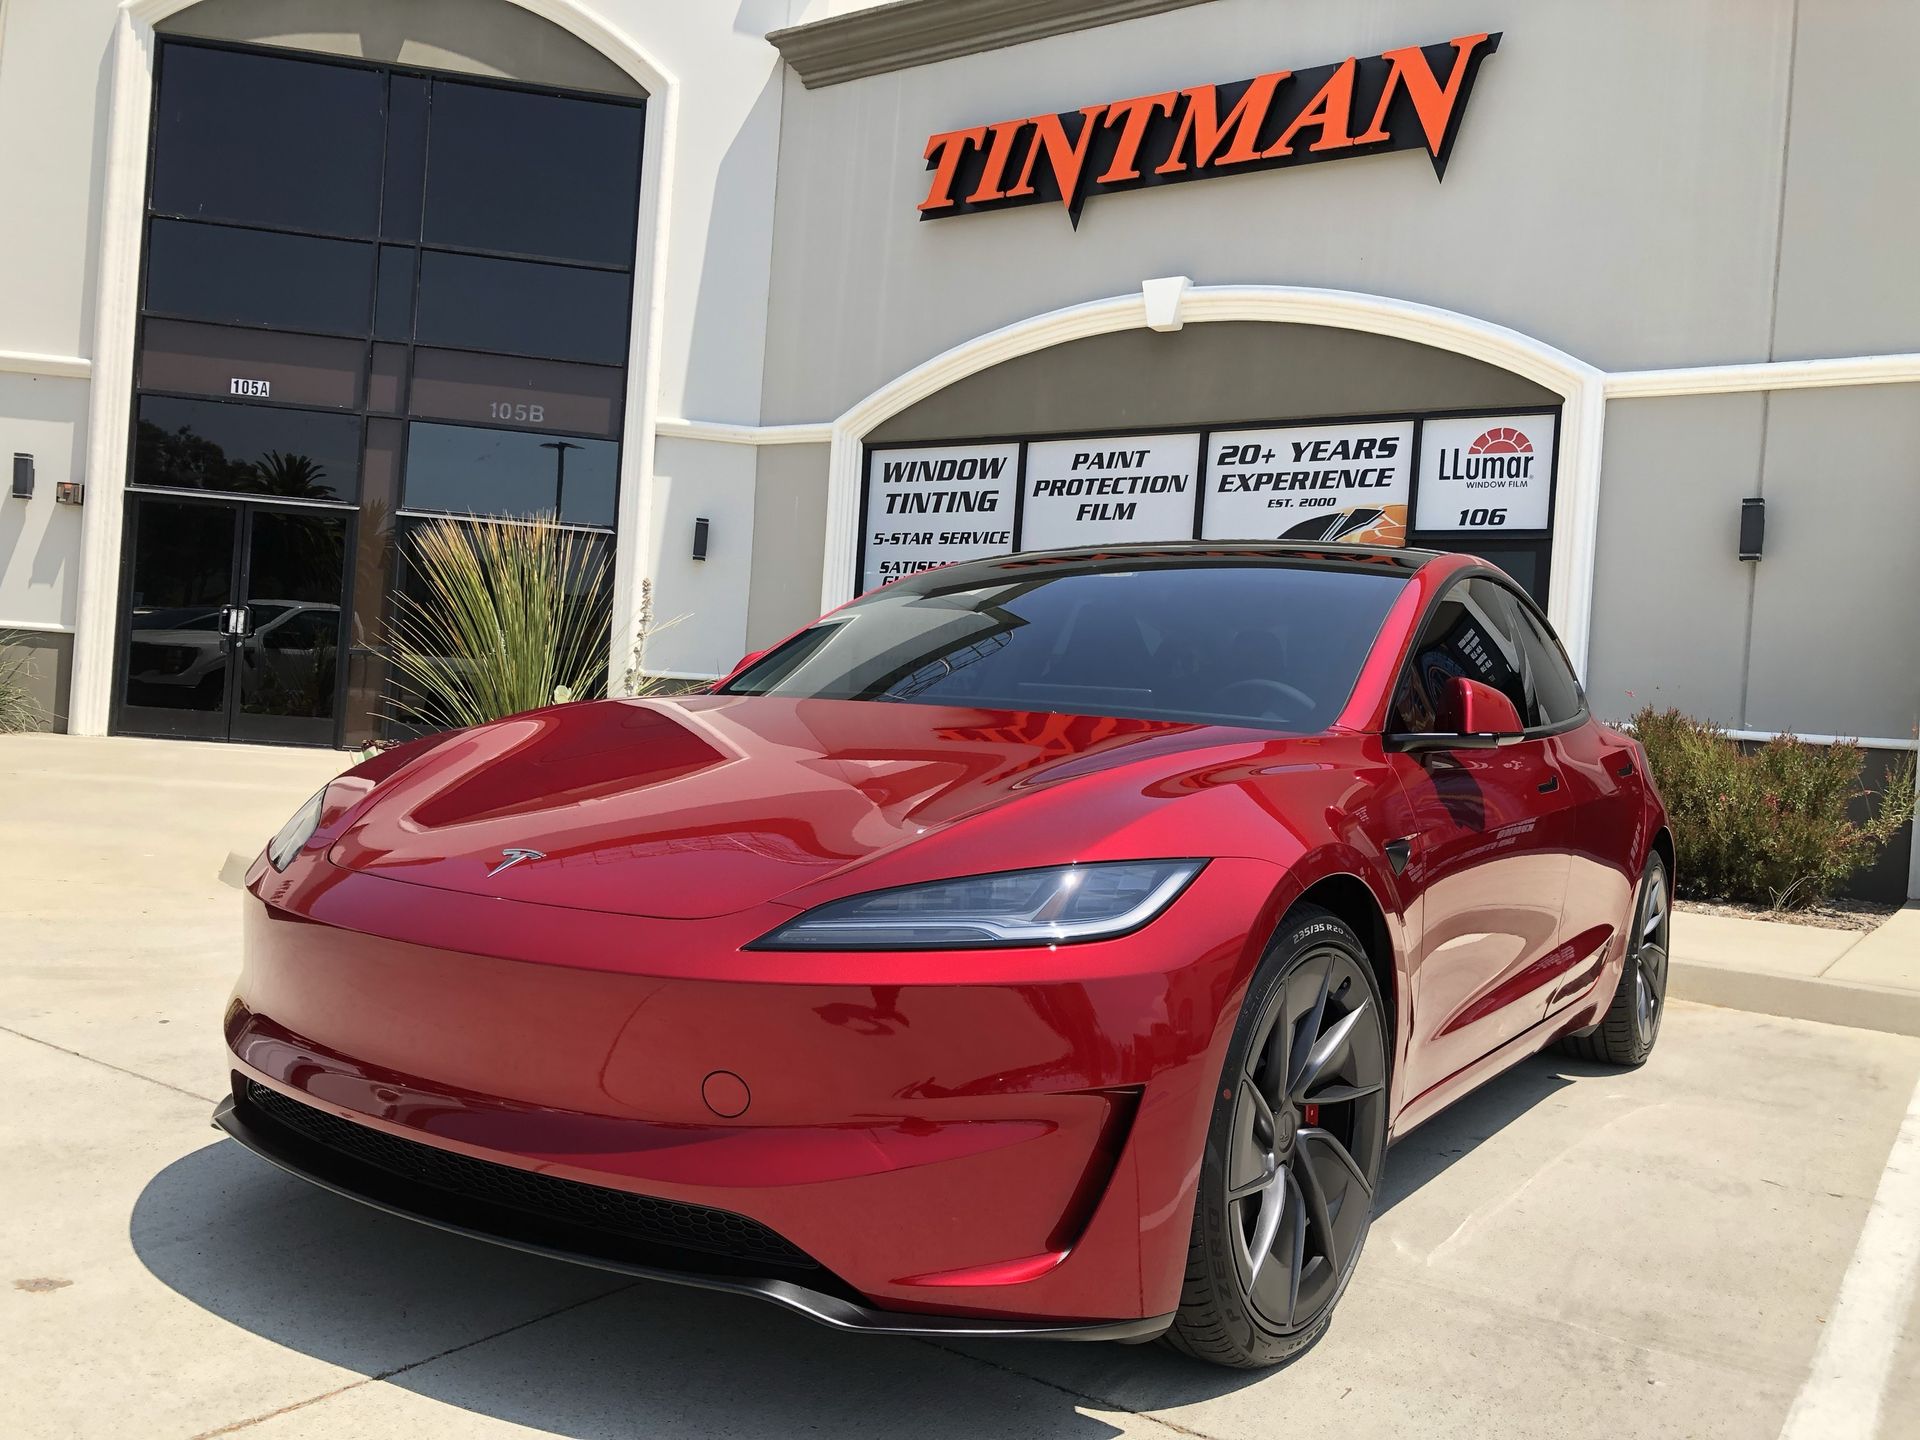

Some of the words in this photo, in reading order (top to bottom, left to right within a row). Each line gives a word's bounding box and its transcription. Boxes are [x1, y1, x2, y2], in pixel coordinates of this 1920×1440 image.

[917, 32, 1490, 212] TINTMAN
[232, 379, 268, 396] 105A
[489, 401, 545, 423] 105B
[1071, 449, 1151, 471] PAINT
[1217, 443, 1276, 466] 20+
[1291, 436, 1400, 463] YEARS
[883, 456, 1008, 483] WINDOW
[1438, 448, 1535, 481] LLumar
[1032, 474, 1189, 498] PROTECTION
[1217, 467, 1395, 493] EXPERIENCE
[1466, 481, 1506, 489] WINDOW
[1508, 480, 1528, 488] FILM
[885, 490, 999, 515] TINTING
[1076, 502, 1137, 521] FILM
[1267, 498, 1294, 508] EST.
[1298, 497, 1337, 508] 2000
[1459, 508, 1508, 526] 106
[873, 531, 932, 546] 5-STAR
[938, 531, 1010, 545] SERVICE
[1293, 923, 1325, 944] 235/35
[1326, 923, 1344, 935] R20
